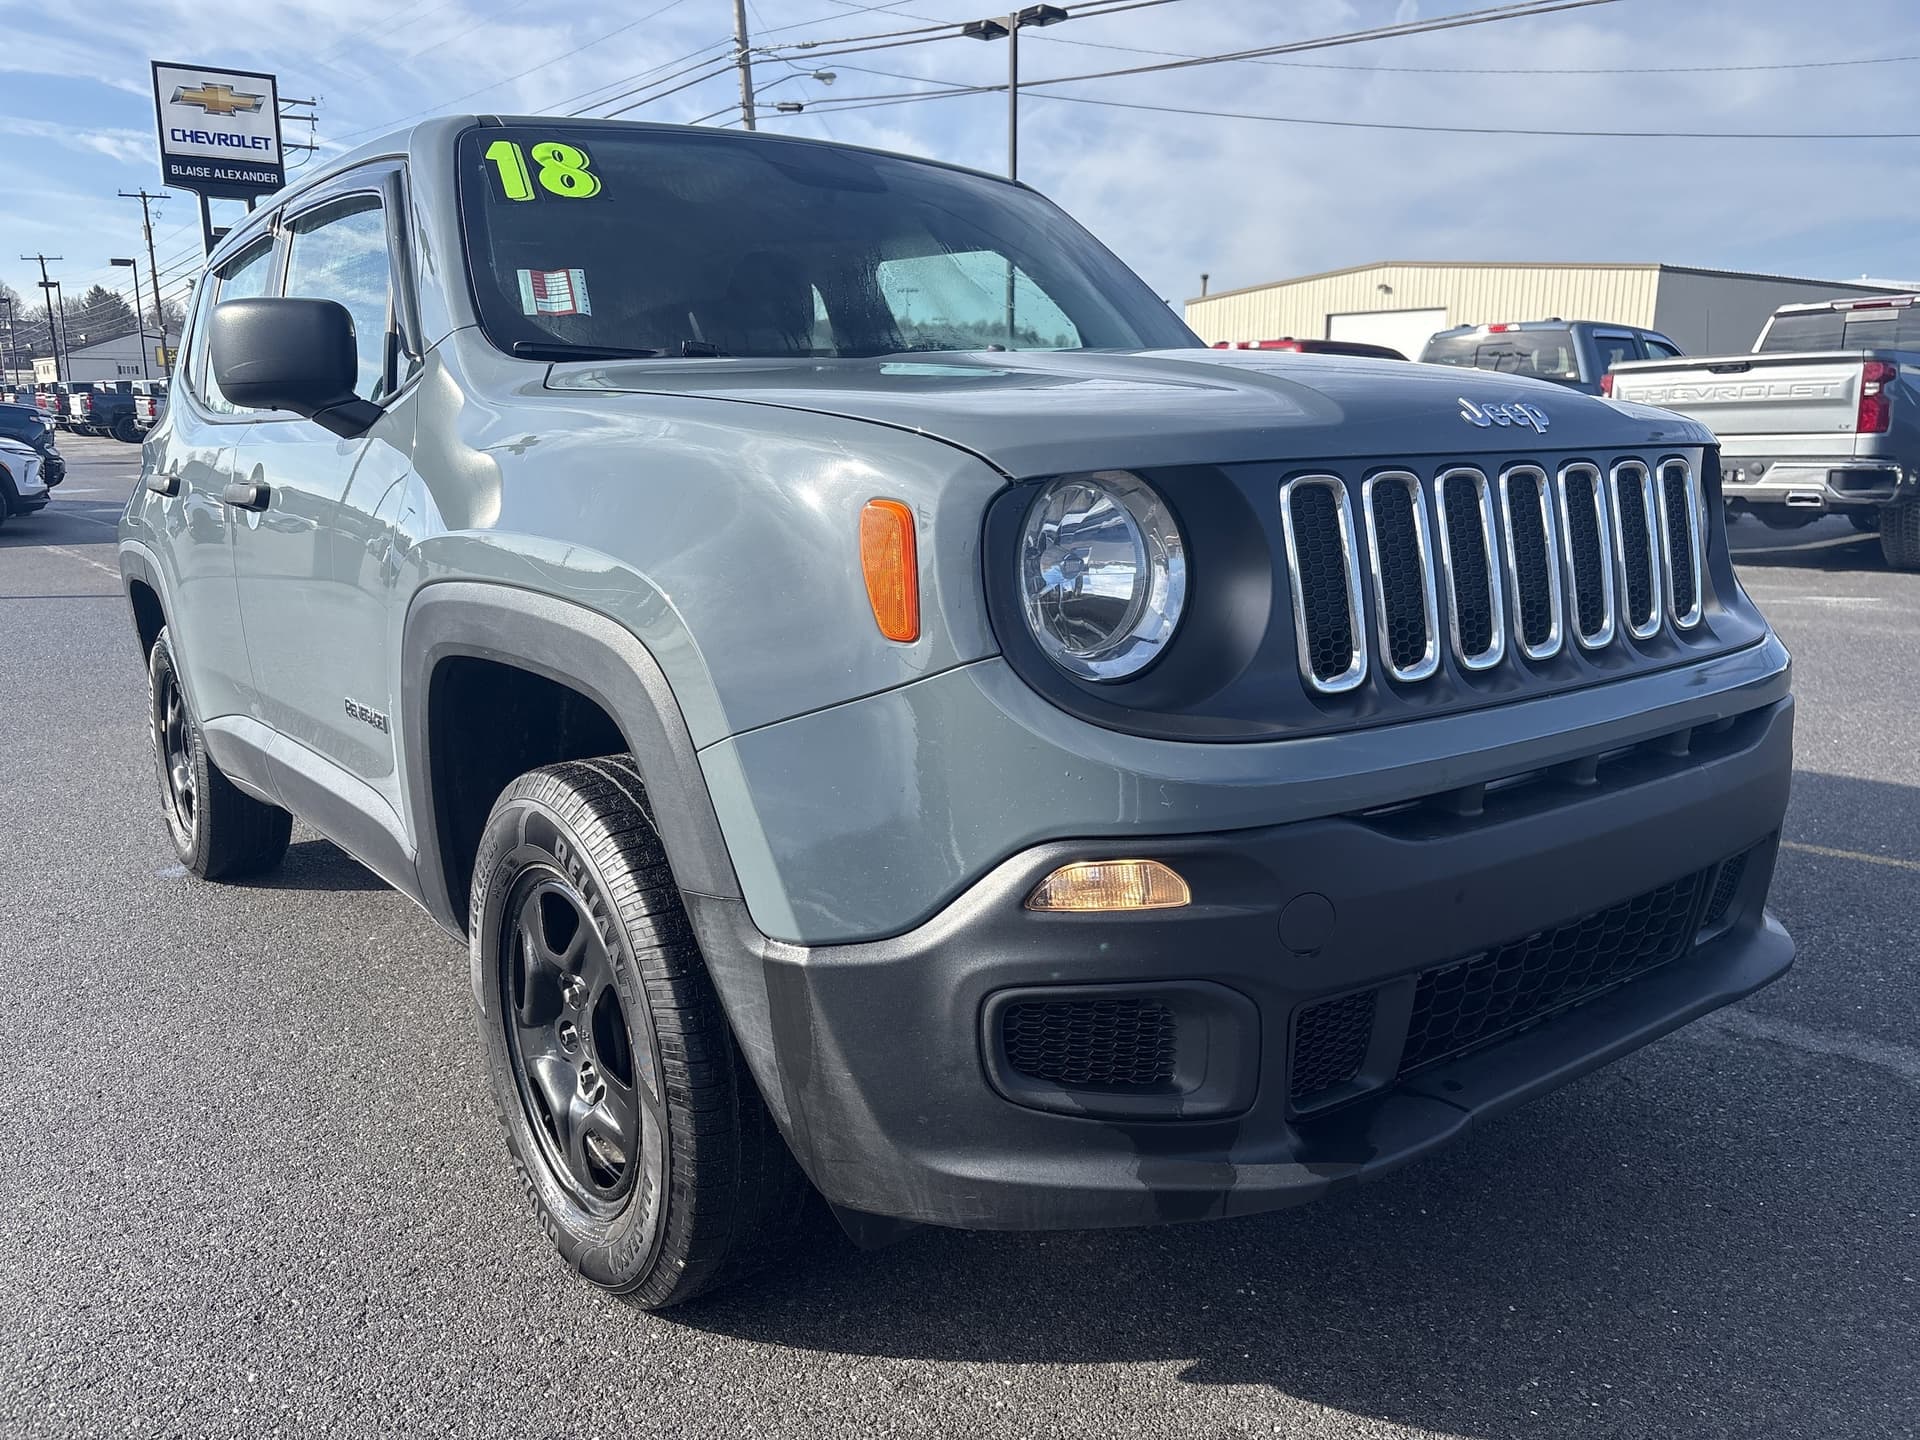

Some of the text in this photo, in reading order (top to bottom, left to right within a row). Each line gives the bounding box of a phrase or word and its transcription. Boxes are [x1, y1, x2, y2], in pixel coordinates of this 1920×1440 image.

[171, 128, 271, 150] CHEVROLET
[171, 164, 278, 183] BLAISE ALEXANDER
[485, 140, 602, 202] 18
[1624, 382, 1841, 403] CHEVROLET
[1457, 397, 1550, 434] Jeep
[554, 834, 636, 1006] RELIANT
